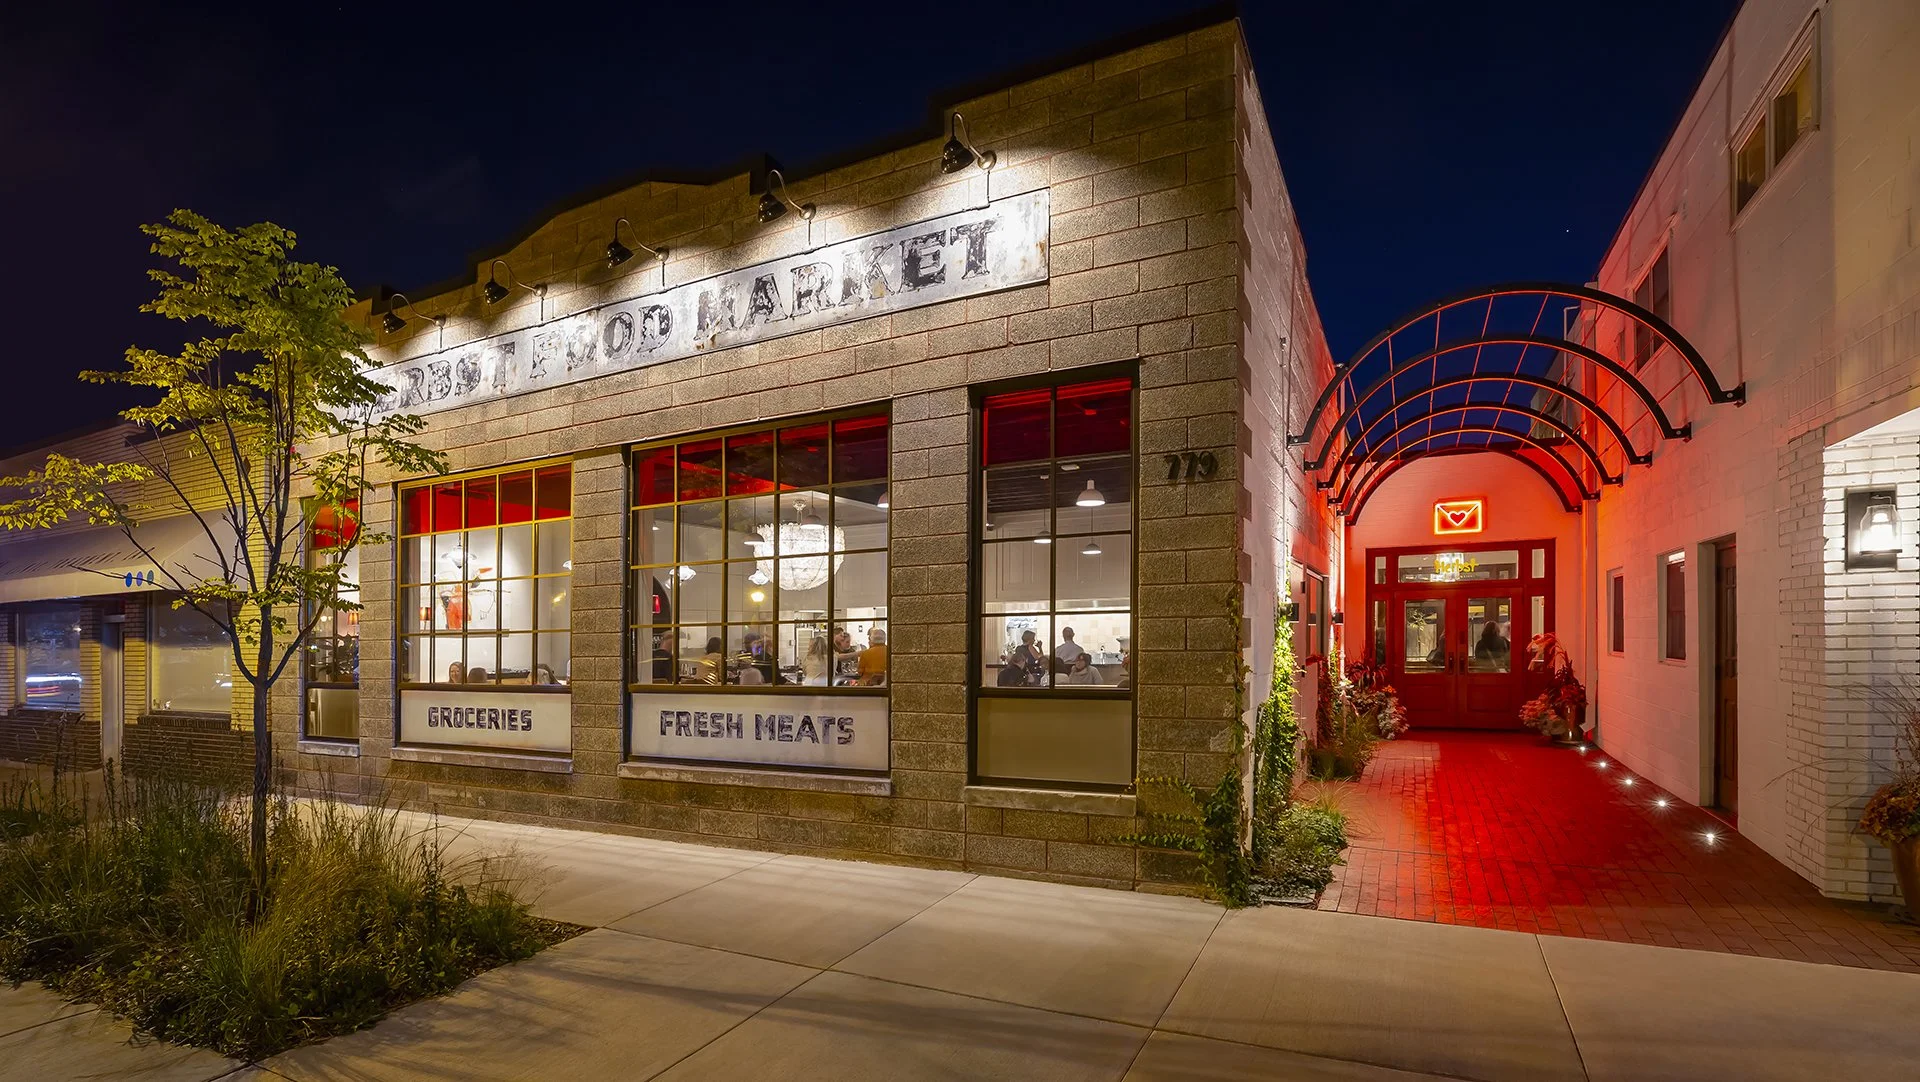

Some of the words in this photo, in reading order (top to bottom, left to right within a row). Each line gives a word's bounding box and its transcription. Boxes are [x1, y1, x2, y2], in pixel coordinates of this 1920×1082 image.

[530, 302, 674, 379] FOOD
[693, 217, 998, 342] MARKET
[1163, 450, 1219, 481] 779
[428, 706, 533, 732] GROCERIES
[660, 710, 744, 740] FRESH
[754, 714, 856, 745] MEATS
